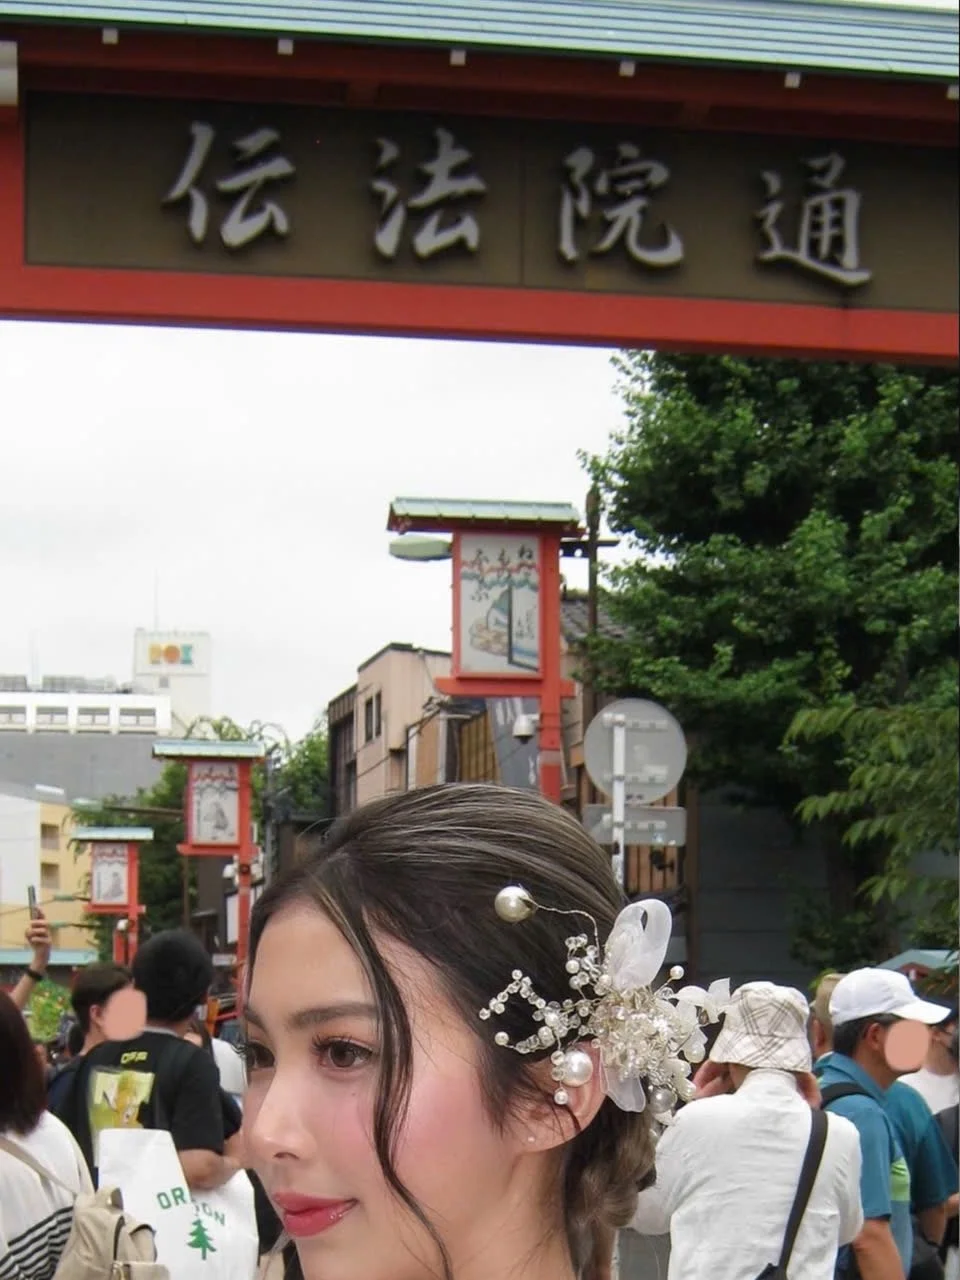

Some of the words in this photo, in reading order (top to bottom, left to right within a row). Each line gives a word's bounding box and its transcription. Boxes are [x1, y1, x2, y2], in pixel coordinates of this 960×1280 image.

[166, 120, 873, 287] 伝法院通
[156, 1187, 226, 1227] ORON
